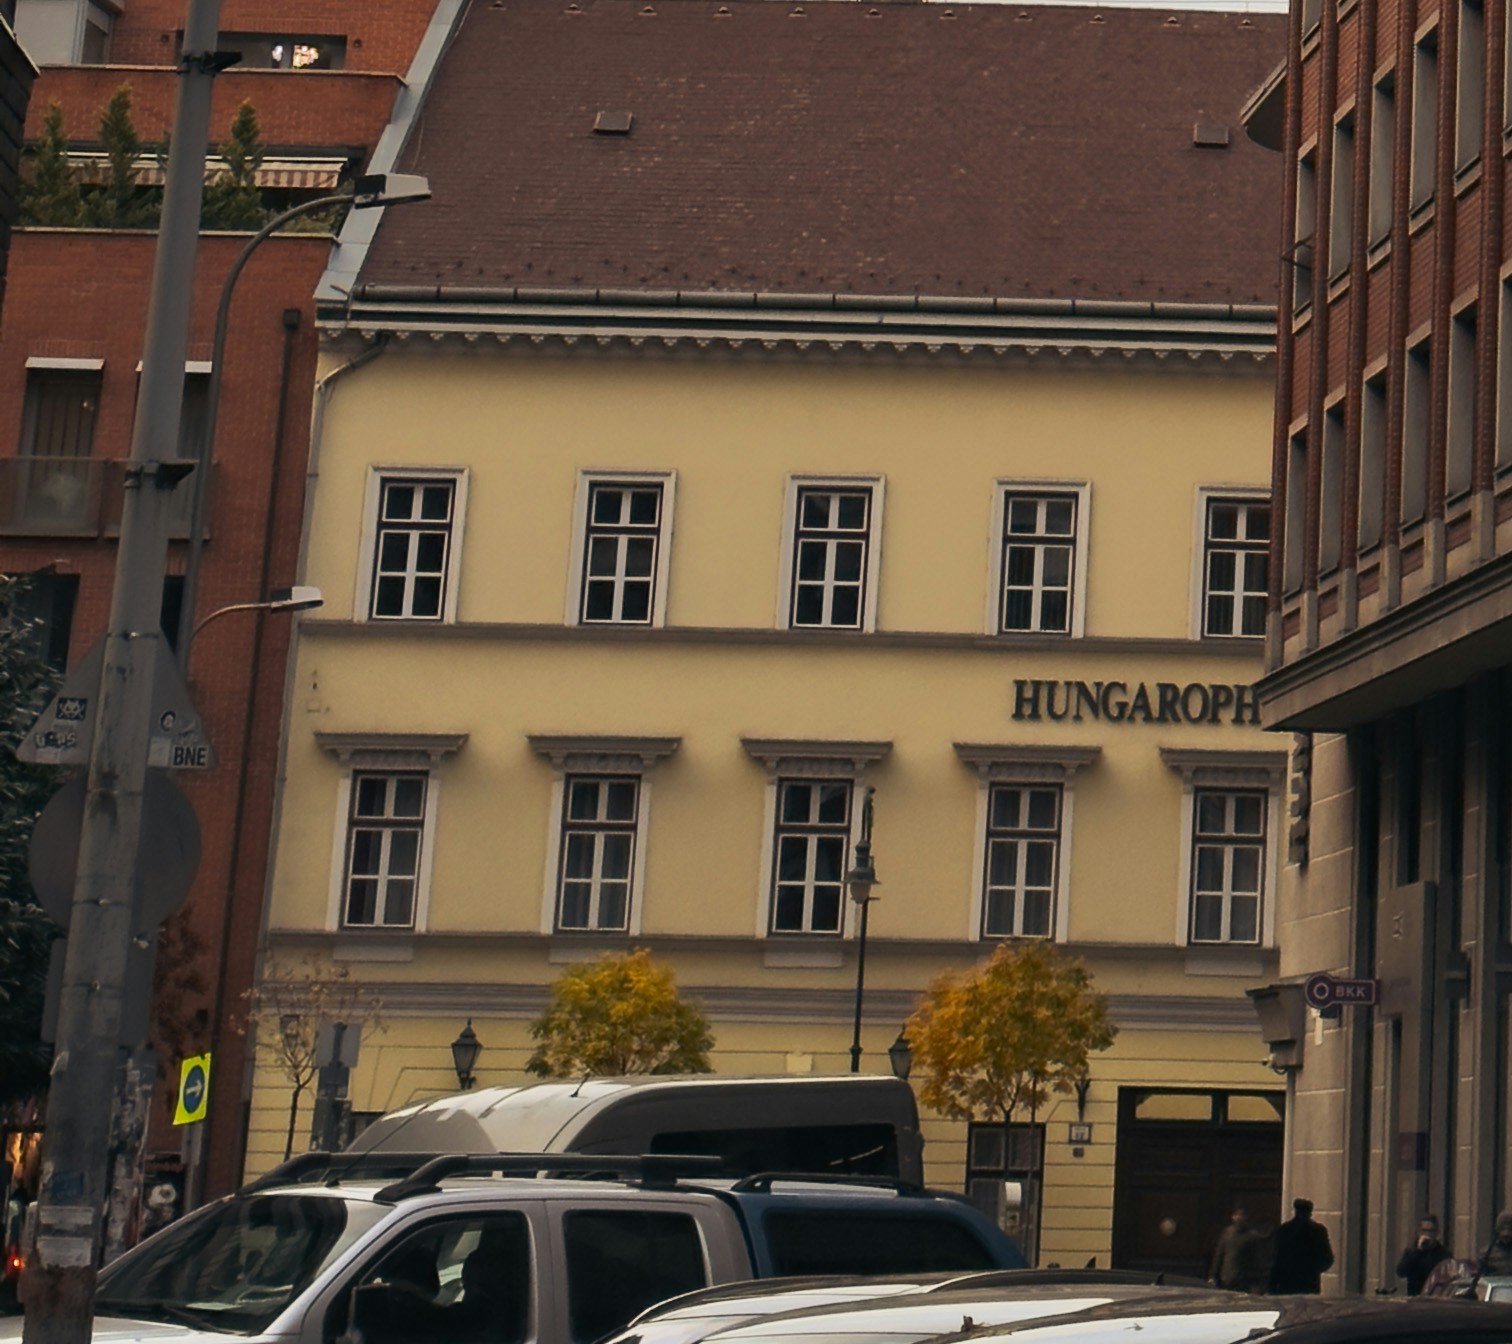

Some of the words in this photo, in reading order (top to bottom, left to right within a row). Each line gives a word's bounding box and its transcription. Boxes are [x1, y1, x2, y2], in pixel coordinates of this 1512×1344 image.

[1011, 679, 1261, 725] HUNGAROPH
[173, 746, 207, 766] BNE
[1335, 986, 1366, 998] BKK
